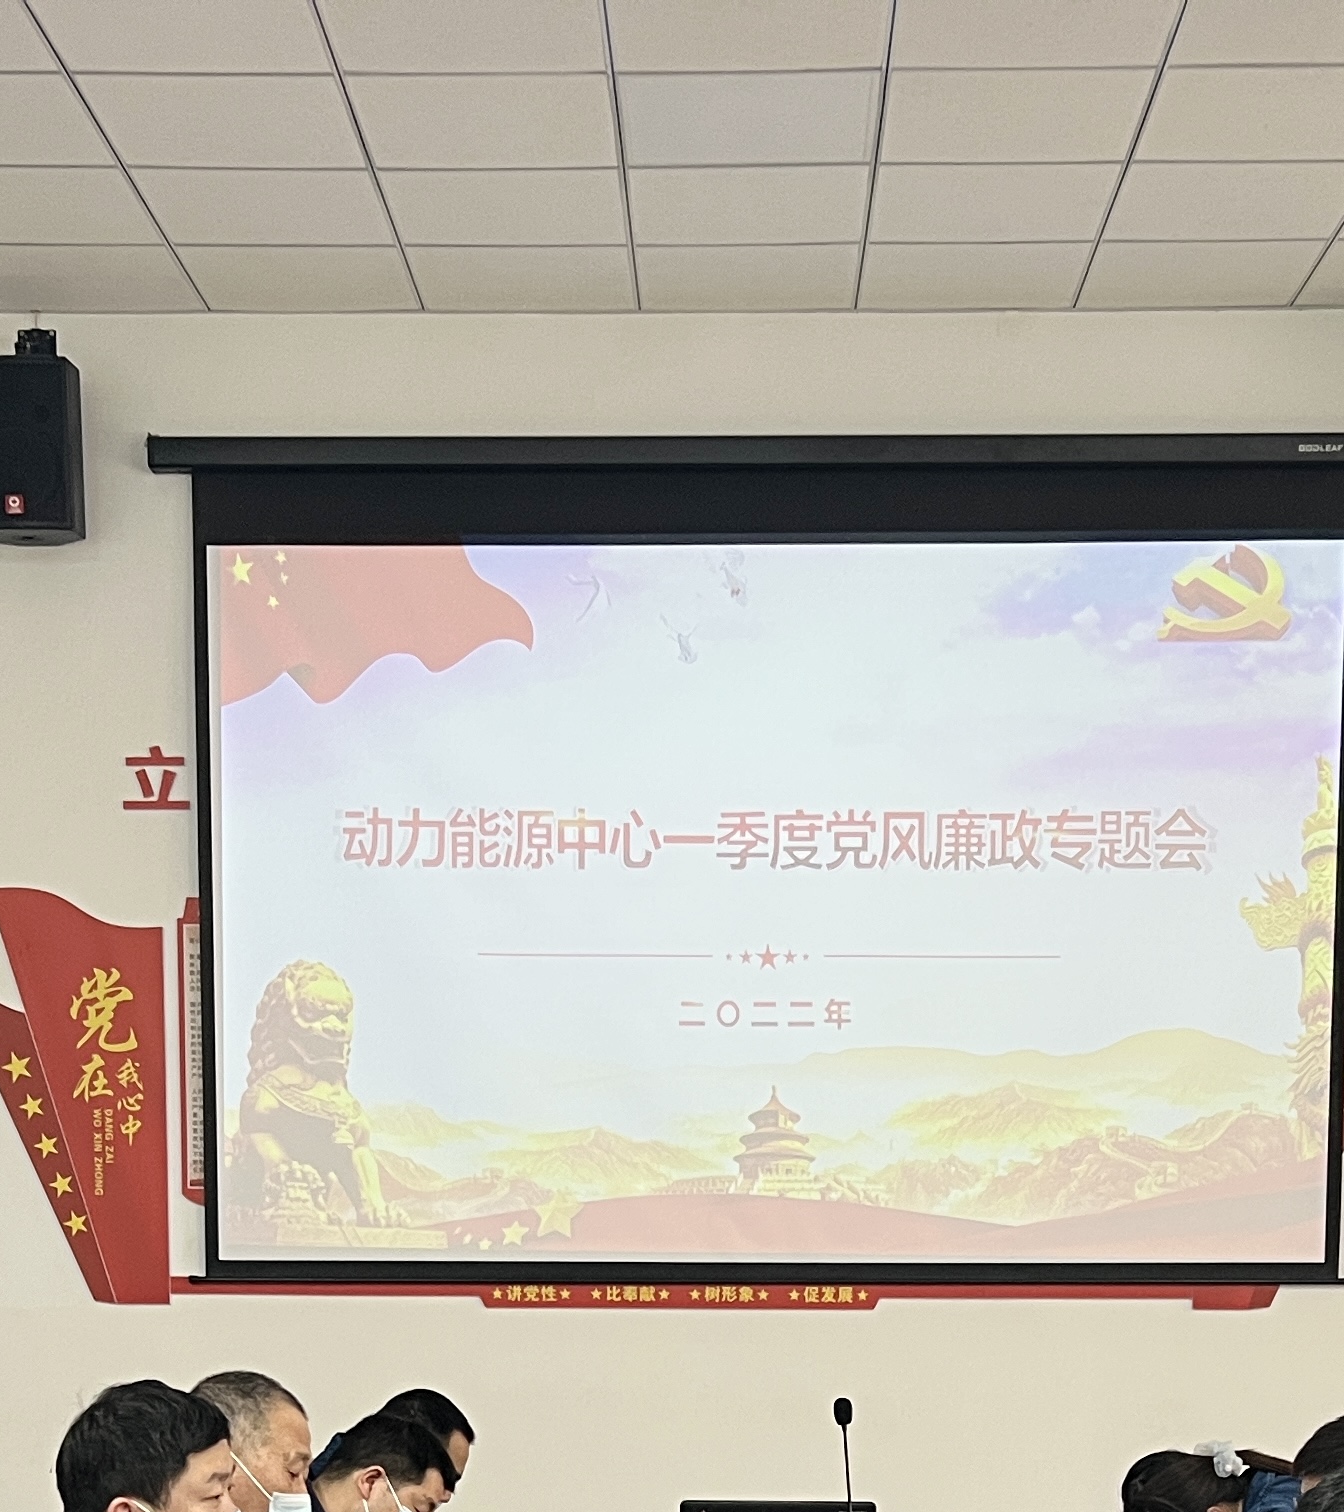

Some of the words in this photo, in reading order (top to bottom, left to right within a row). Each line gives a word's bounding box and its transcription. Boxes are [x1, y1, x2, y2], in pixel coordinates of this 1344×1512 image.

[123, 745, 191, 811] 立
[342, 806, 1208, 870] 动力能源中心一季度党风廉政专题会
[93, 1109, 102, 1129] WO
[105, 1109, 114, 1140] DANG
[93, 1133, 103, 1153] XIN
[105, 1142, 115, 1164] ZAI
[94, 1157, 104, 1196] ZHONG
[506, 1286, 558, 1303] 讲党性
[605, 1286, 657, 1303] 比奉献
[704, 1286, 756, 1303] 树形象
[803, 1286, 854, 1304] 促发展
